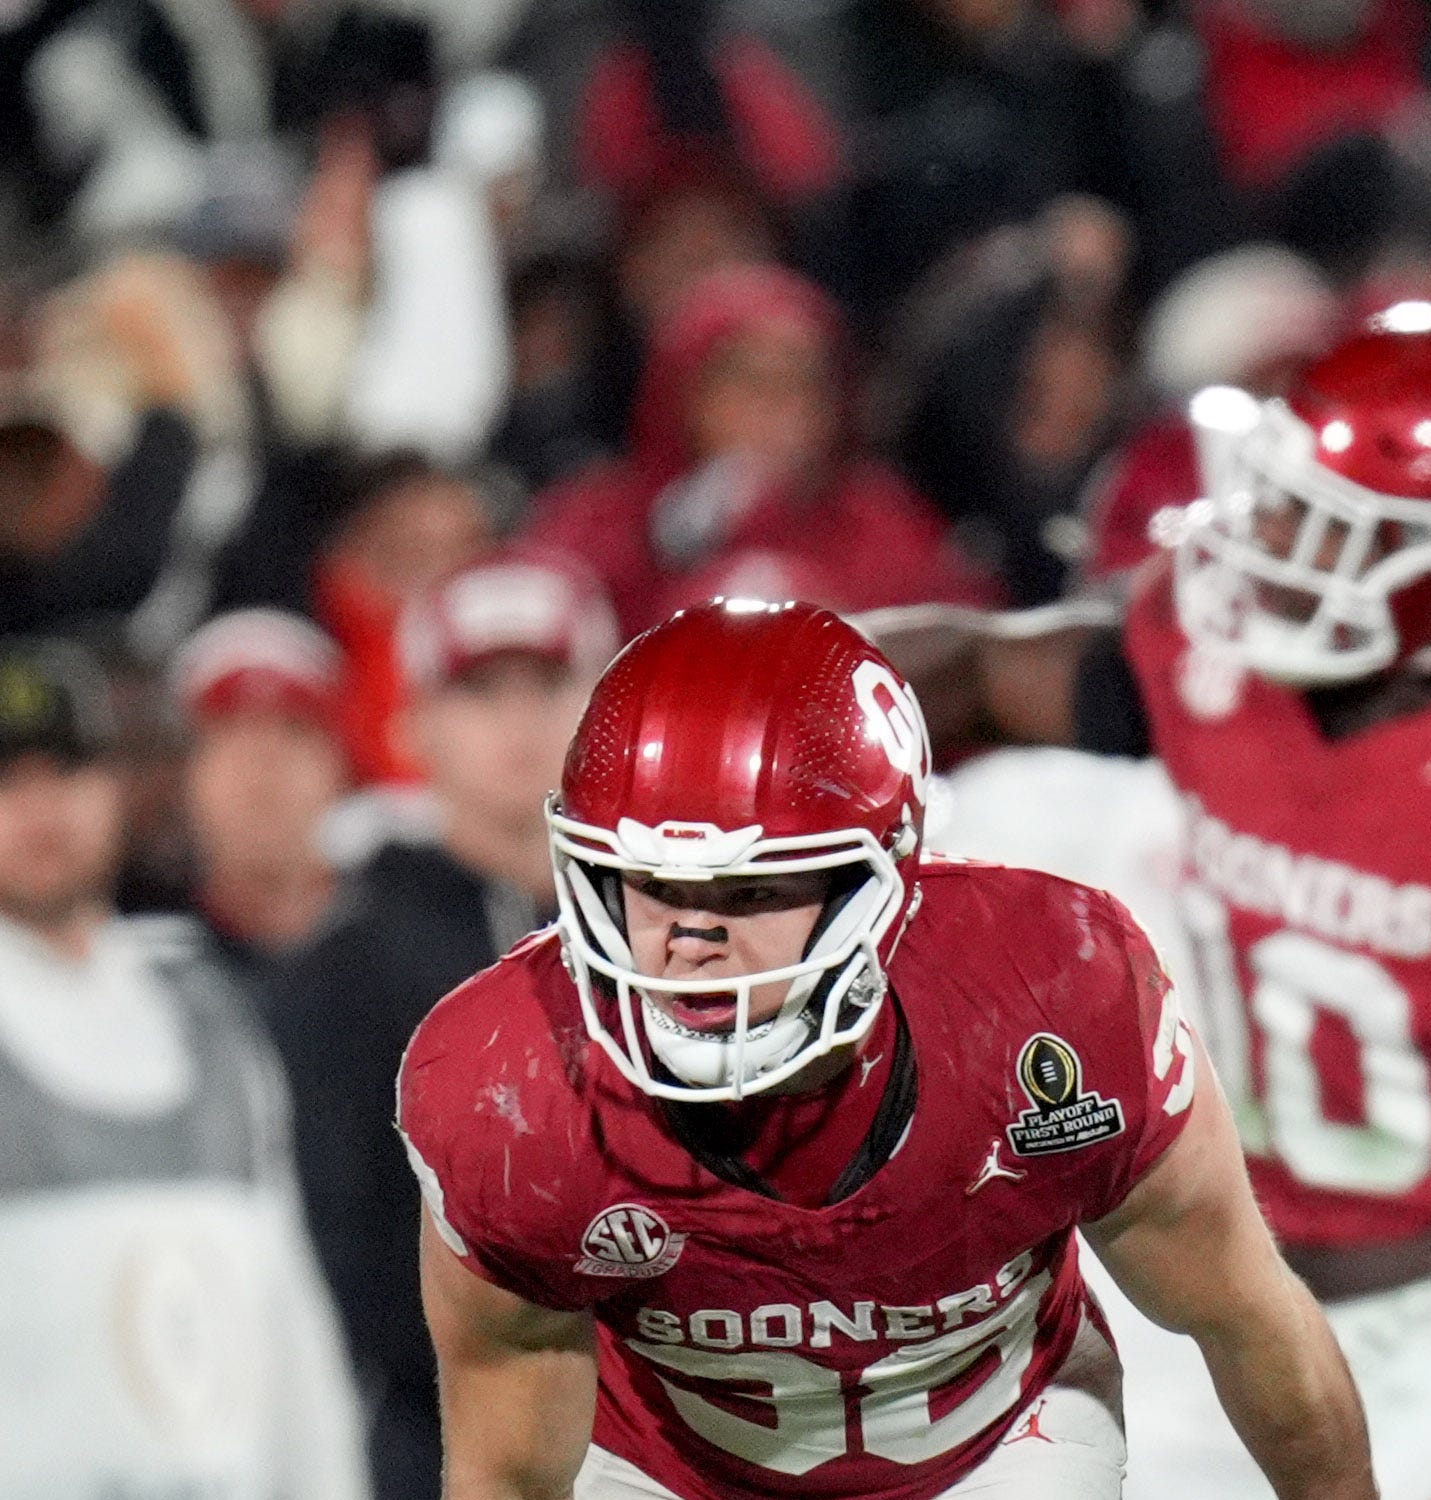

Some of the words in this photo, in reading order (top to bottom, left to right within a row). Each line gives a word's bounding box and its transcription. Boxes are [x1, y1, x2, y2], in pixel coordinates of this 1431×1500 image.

[1013, 1124, 1060, 1141] FIRST
[1062, 1107, 1115, 1133] ROUND
[1027, 1099, 1095, 1127] PLAYOFF
[588, 1208, 663, 1263] SEC
